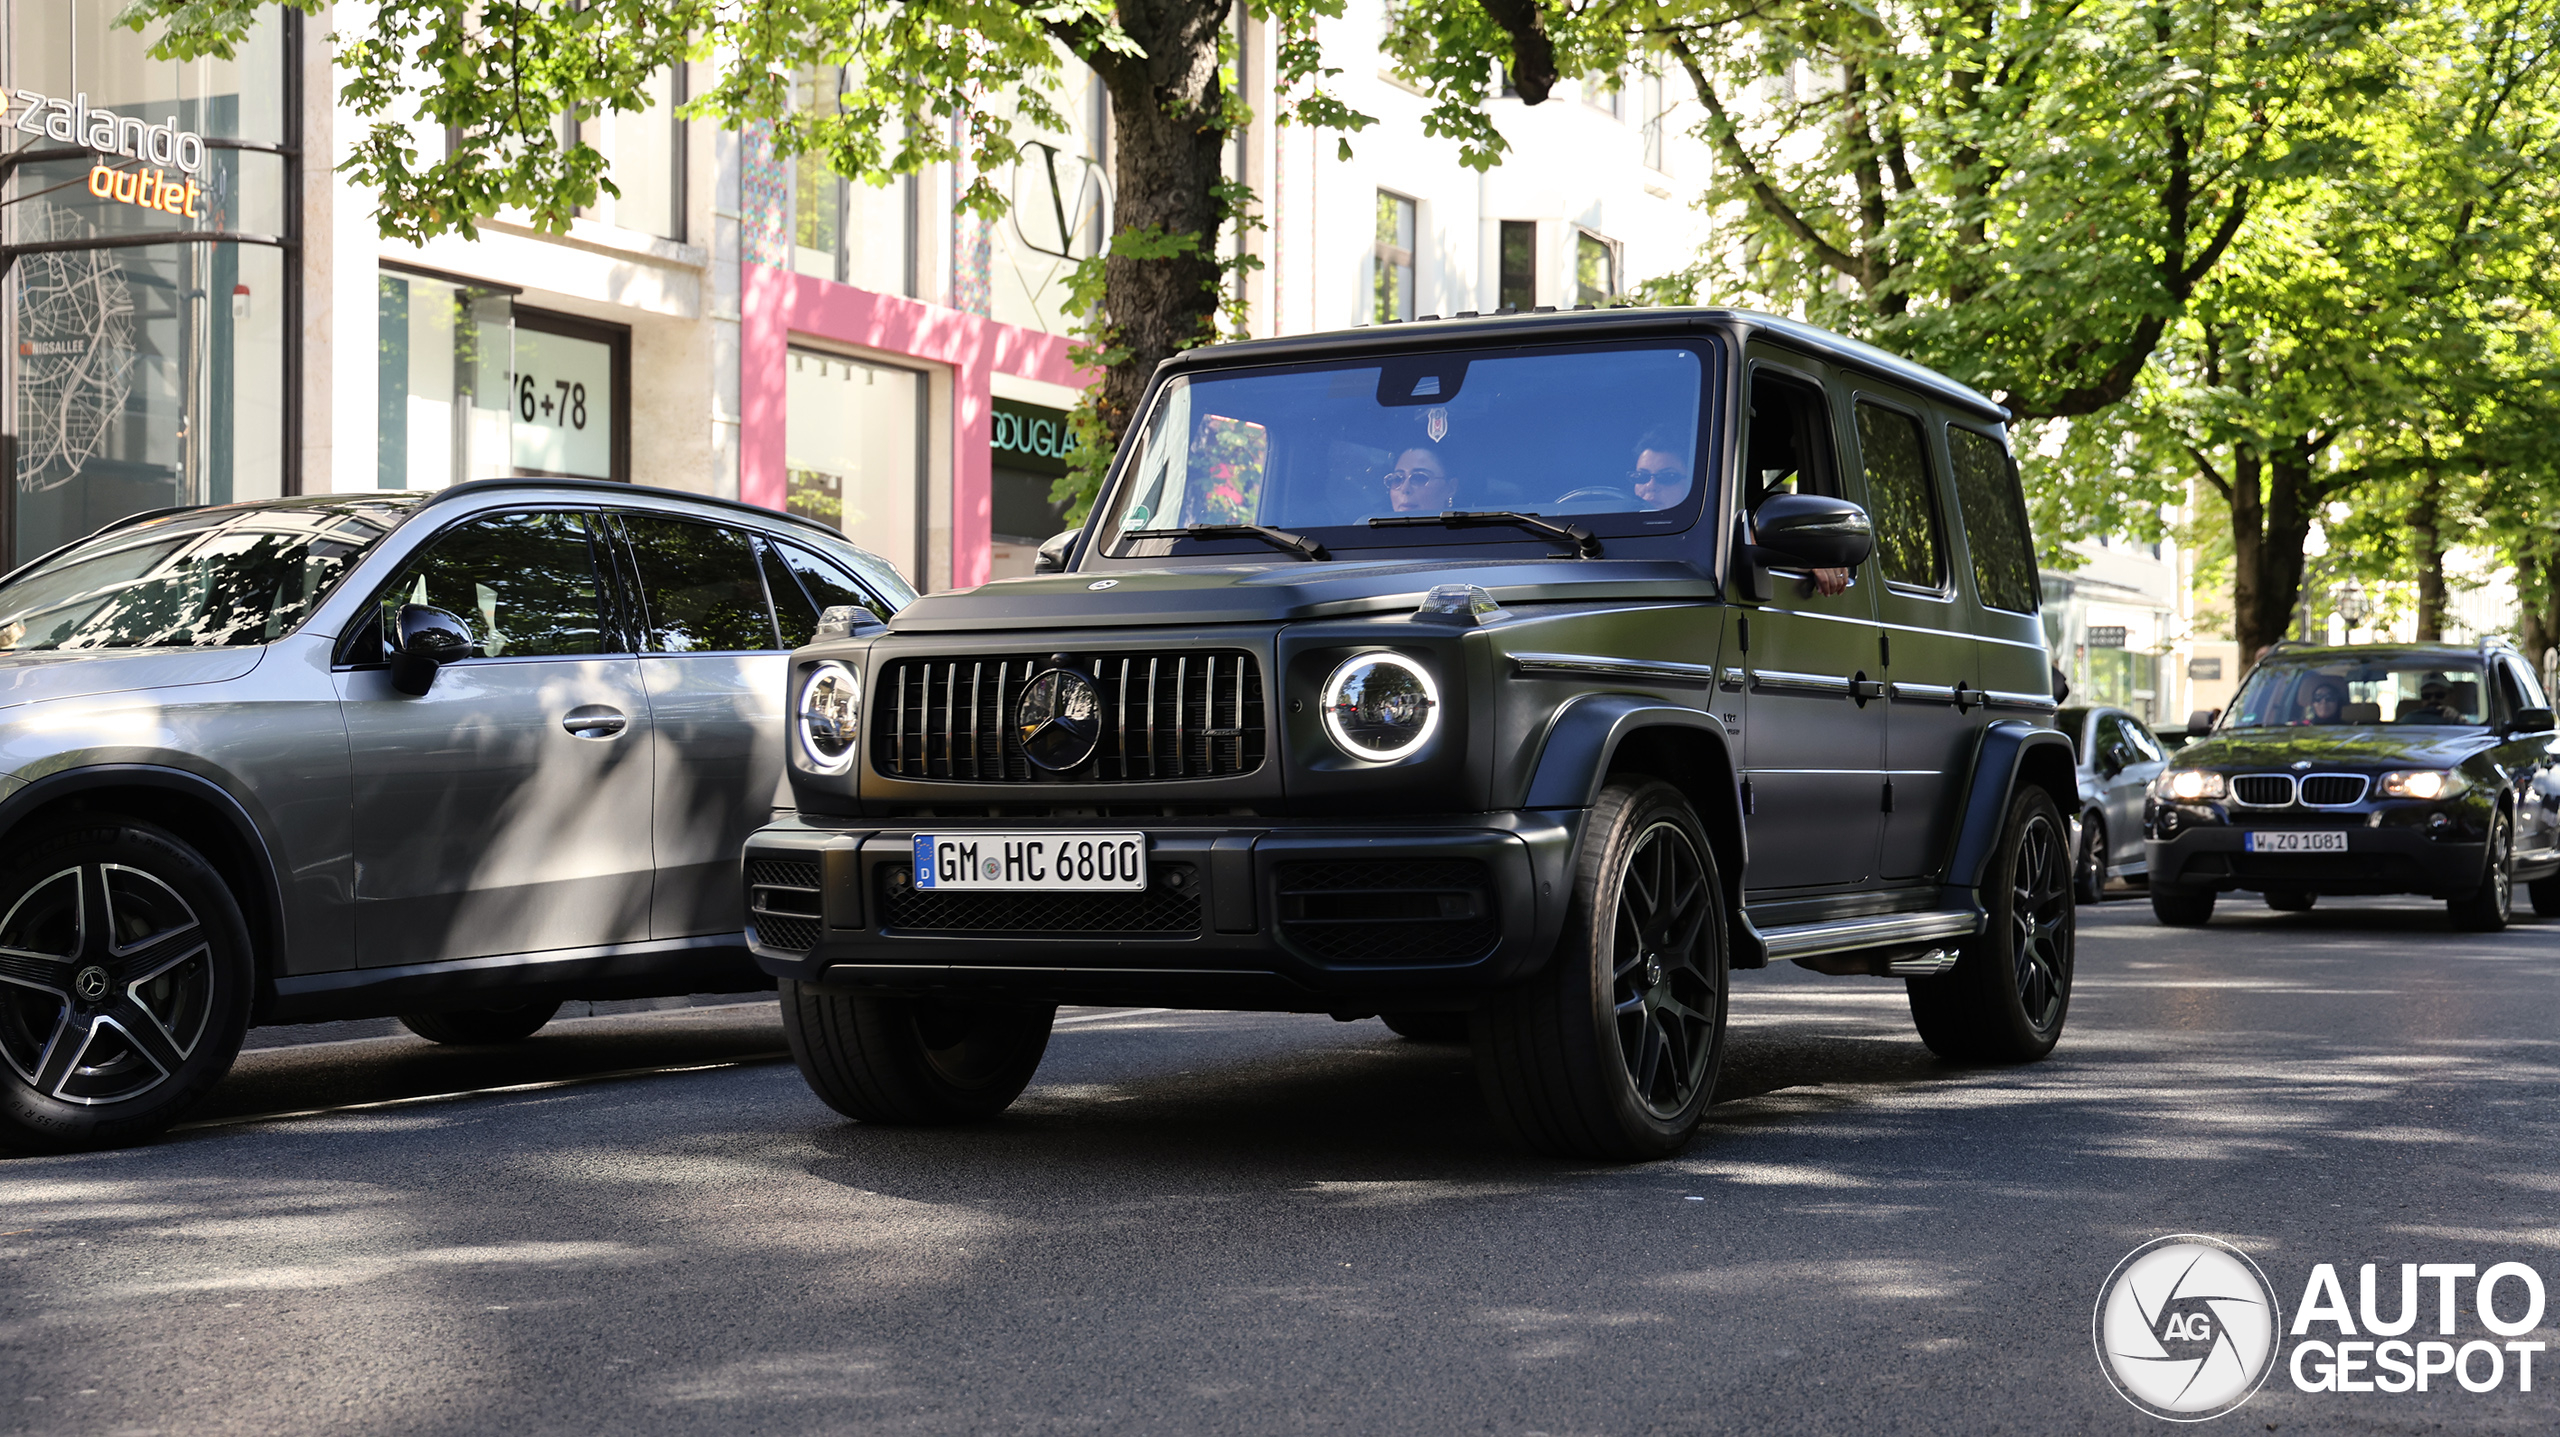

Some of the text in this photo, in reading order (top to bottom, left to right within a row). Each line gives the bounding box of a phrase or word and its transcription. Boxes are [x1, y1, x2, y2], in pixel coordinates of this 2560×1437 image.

[17, 89, 205, 173] zalando
[89, 165, 201, 218] outlet
[989, 410, 1086, 459] DOUGLA
[921, 841, 1138, 882] D GM HC 6800
[2256, 834, 2344, 849] W ZQ 1081
